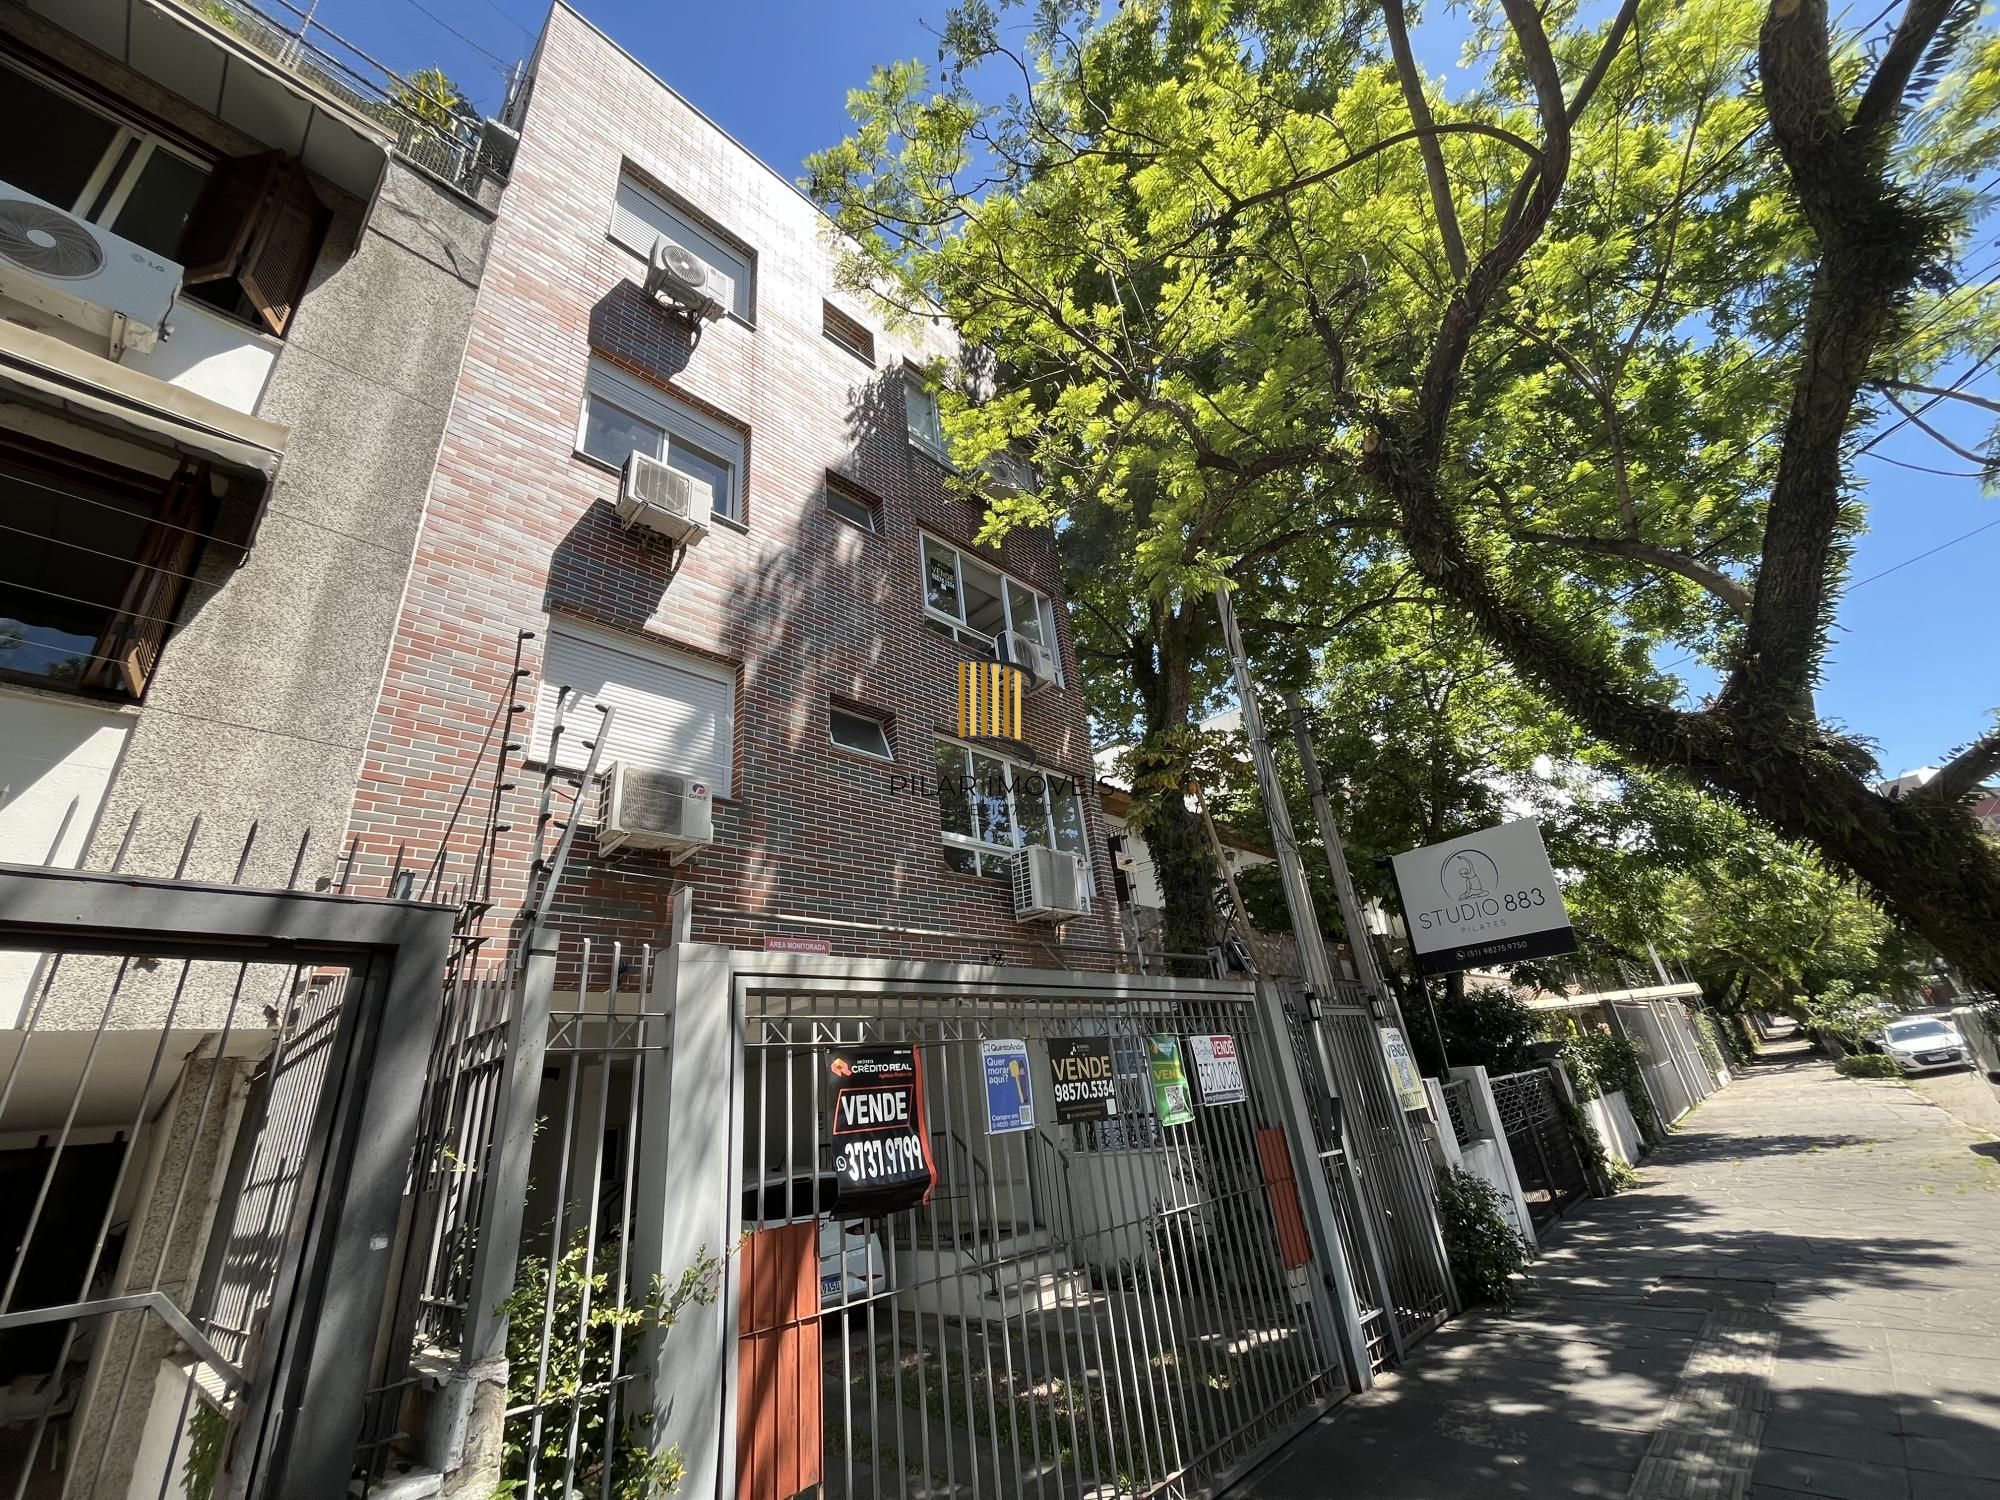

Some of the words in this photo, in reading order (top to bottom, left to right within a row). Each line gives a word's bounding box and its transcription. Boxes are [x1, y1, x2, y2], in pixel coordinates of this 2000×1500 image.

[148, 261, 165, 273] LG
[1419, 898, 1500, 930] STUDIO
[1504, 887, 1545, 912] 883
[1461, 919, 1507, 934] PILATES
[769, 939, 787, 948] ÁREA
[787, 941, 826, 951] MONITORADA
[1466, 948, 1481, 958] (51)
[1483, 940, 1528, 955] 98275.9750
[1212, 1040, 1234, 1056] VENDE
[851, 1063, 889, 1074] CRÉDITO
[889, 1063, 912, 1072] REAL
[986, 1057, 1005, 1067] Quer
[1052, 1055, 1112, 1081] VENDE
[987, 1067, 1009, 1076] morar
[988, 1074, 1009, 1086] aqui?
[1054, 1079, 1115, 1102] 98570.5334
[841, 1091, 908, 1126] VENDE
[844, 1134, 924, 1181] 3737.9799
